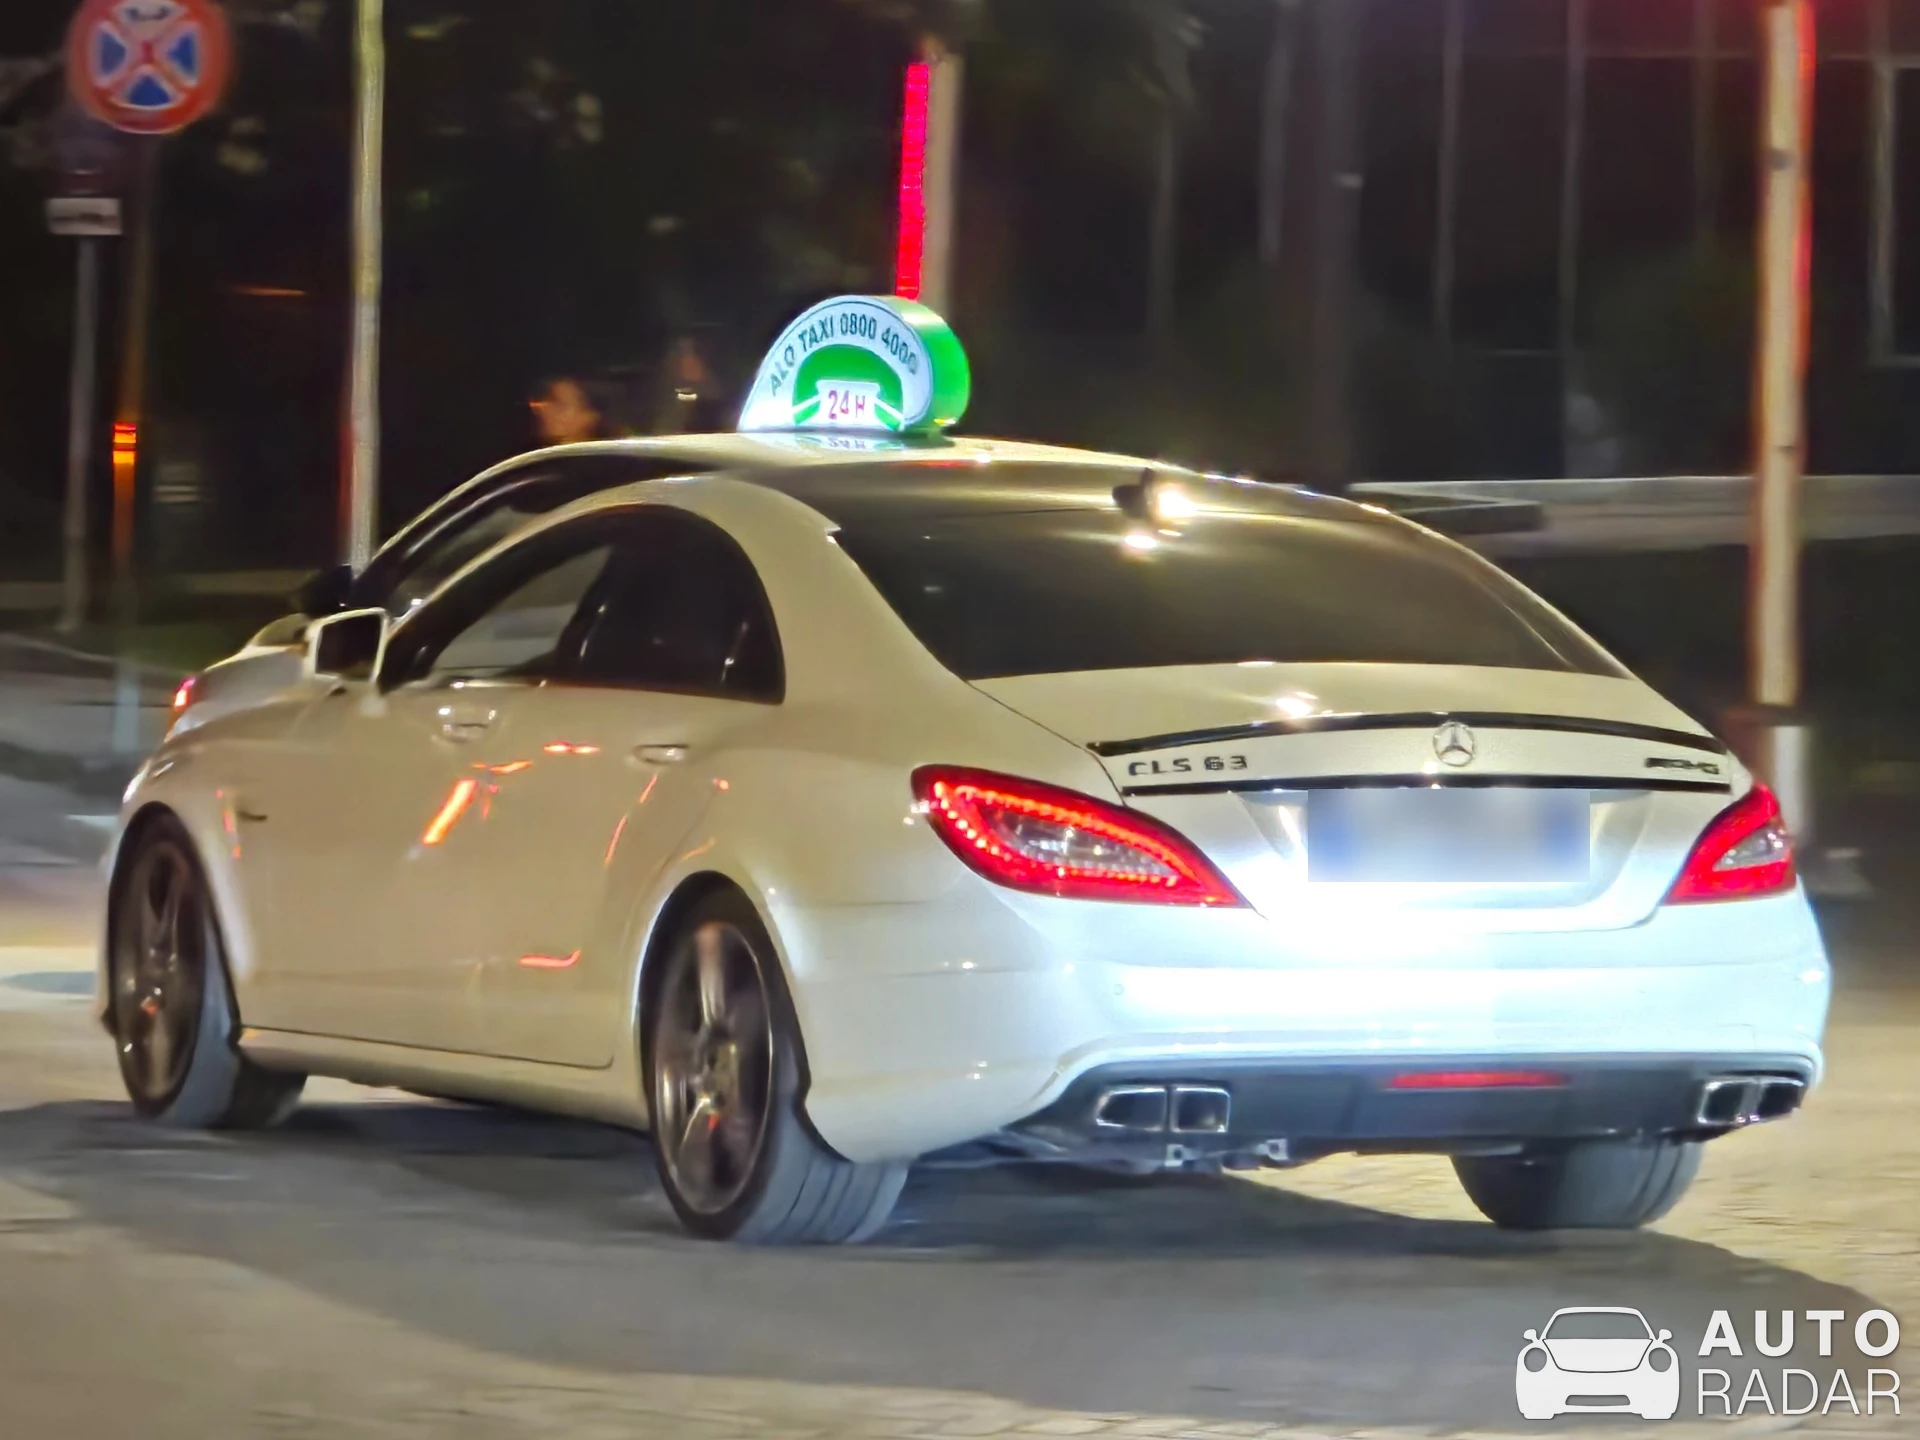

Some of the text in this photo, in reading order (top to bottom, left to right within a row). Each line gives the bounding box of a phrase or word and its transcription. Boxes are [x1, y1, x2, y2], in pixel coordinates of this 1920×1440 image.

[768, 346, 796, 396] ALO
[798, 313, 835, 354] TAXI
[840, 312, 878, 339] 0800
[828, 389, 866, 420] 24 H
[1128, 755, 1248, 776] CLS 63
